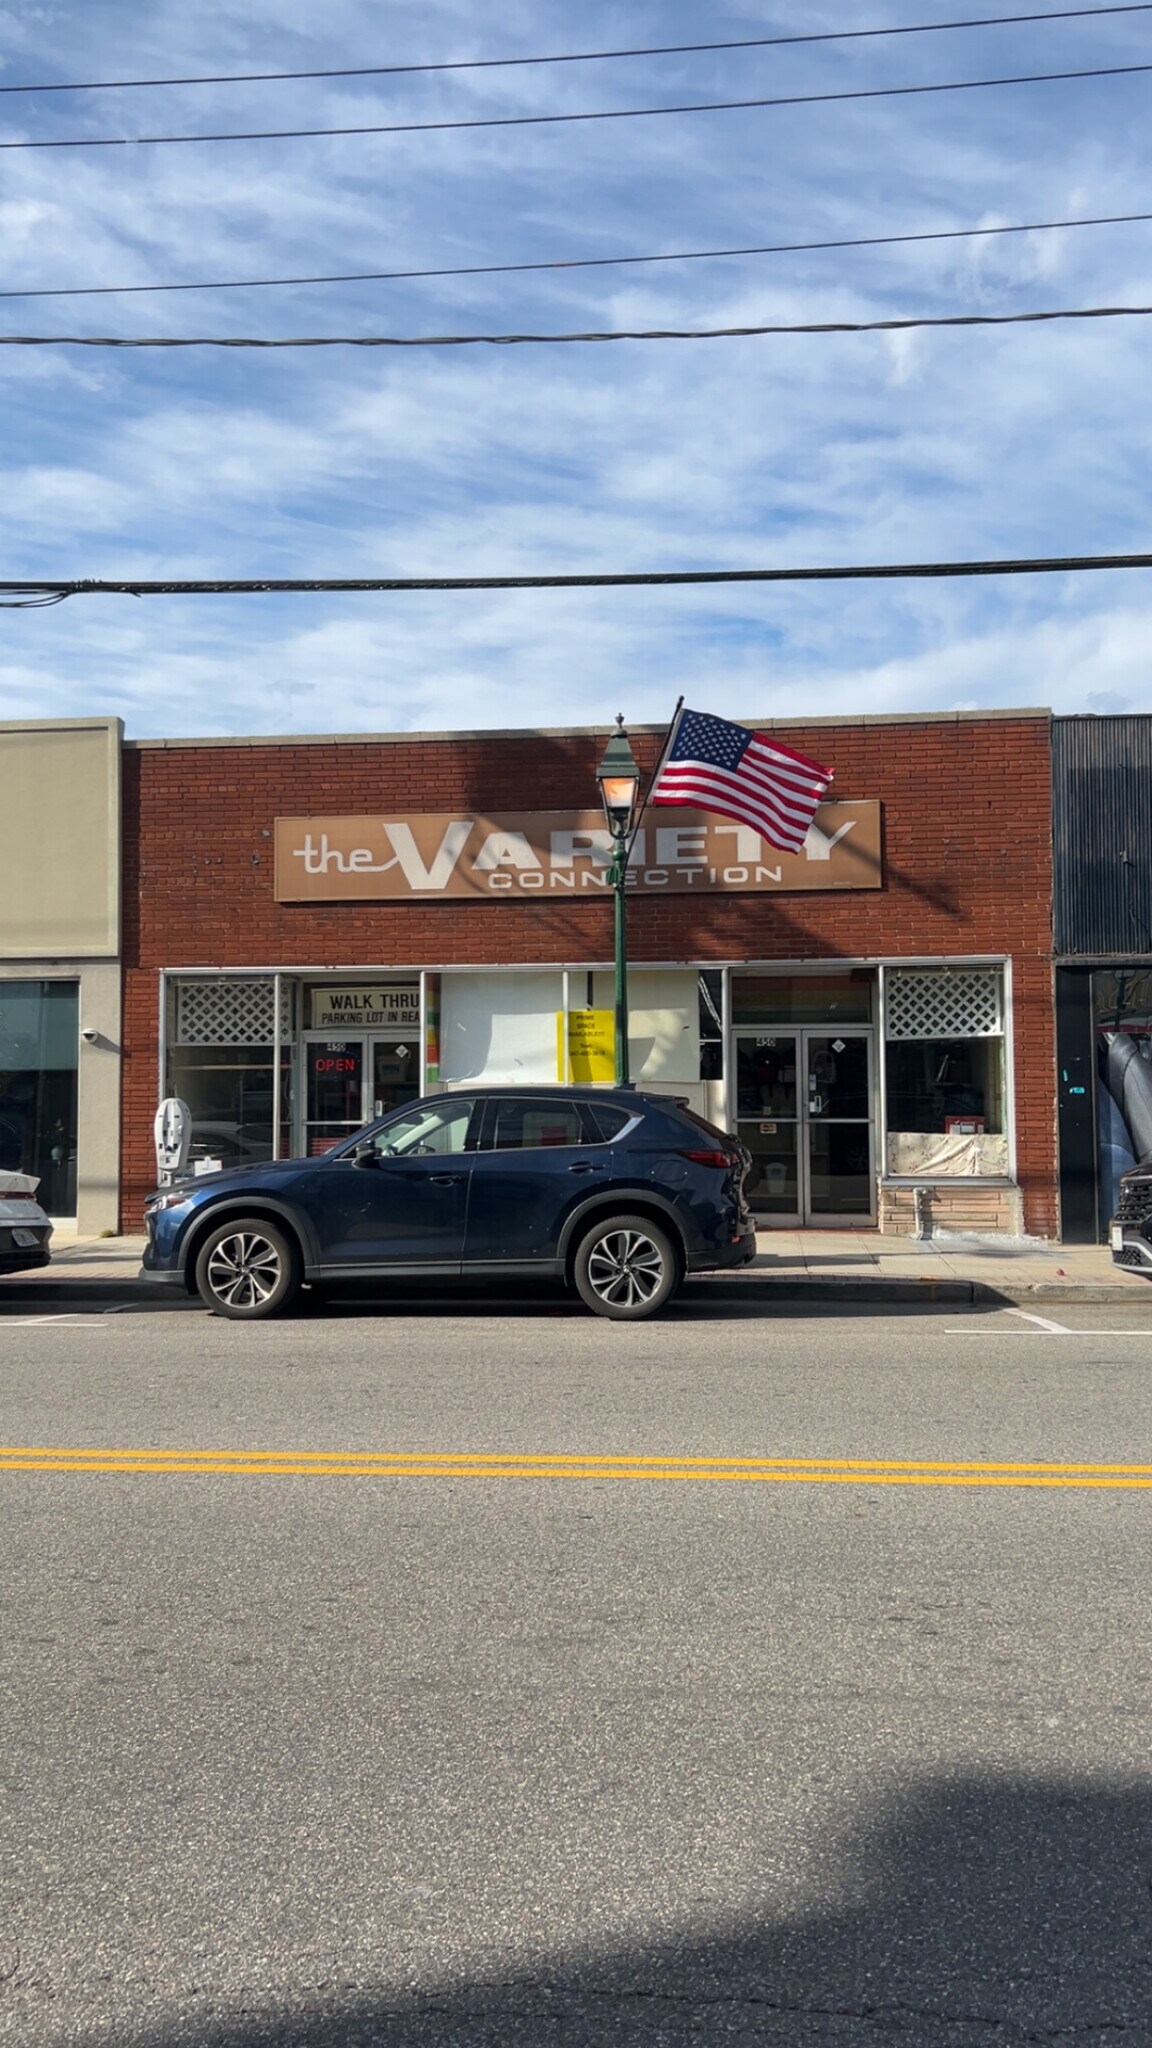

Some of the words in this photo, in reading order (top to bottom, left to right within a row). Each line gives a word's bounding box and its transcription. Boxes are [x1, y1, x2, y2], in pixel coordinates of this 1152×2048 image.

[293, 834, 398, 873] the
[383, 821, 857, 889] VARIETY
[487, 865, 782, 889] CONNECTION
[330, 994, 373, 1009] WALK
[379, 993, 420, 1009] THRU
[321, 1012, 363, 1024] PARKING
[366, 1011, 385, 1023] LOT
[388, 1011, 398, 1022] IN
[401, 1010, 420, 1023] REA
[315, 1059, 355, 1072] OPEN
